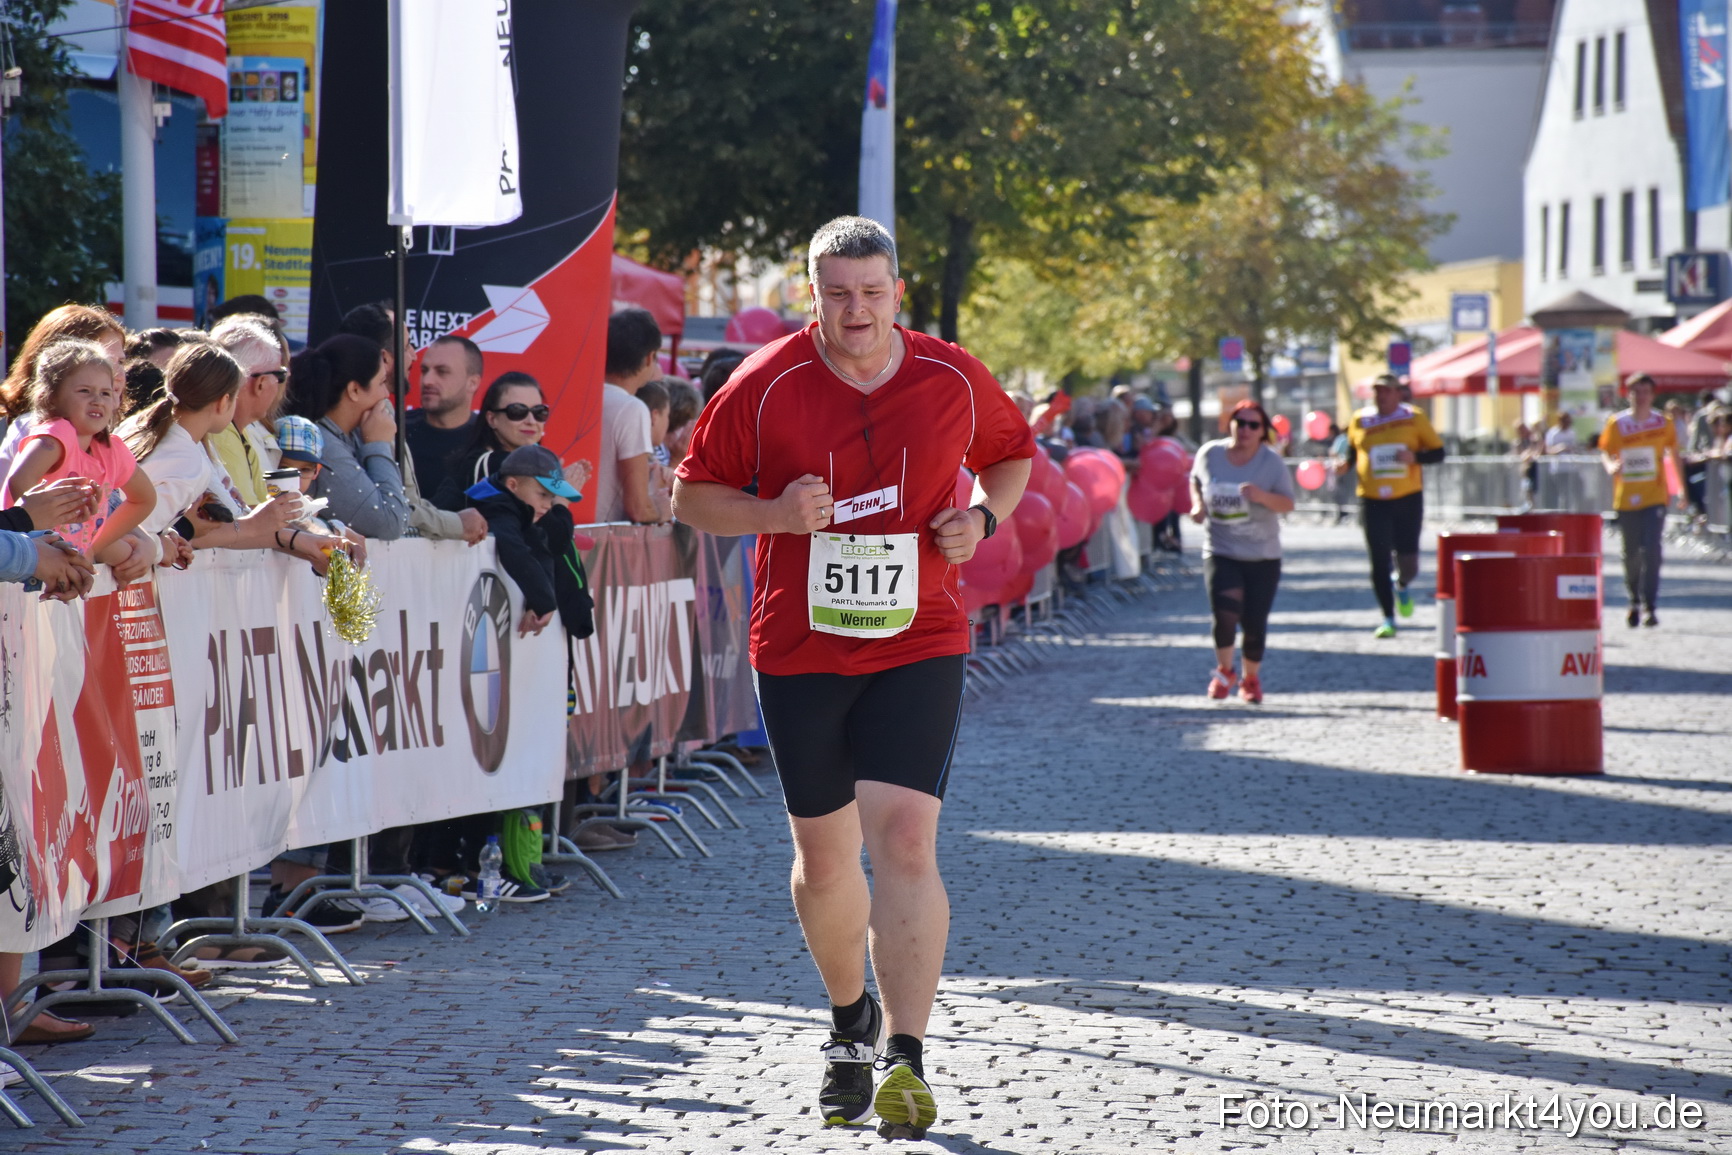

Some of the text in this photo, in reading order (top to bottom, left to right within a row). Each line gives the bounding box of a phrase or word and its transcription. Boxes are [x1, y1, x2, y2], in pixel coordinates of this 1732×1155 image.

[421, 310, 472, 331] NEXT
[852, 496, 881, 512] DEHN
[841, 544, 889, 556] BOCK
[824, 563, 904, 595] 5117
[831, 598, 888, 607] PARTL Neumarkt
[840, 612, 887, 627] Werner
[155, 751, 162, 768] 8
